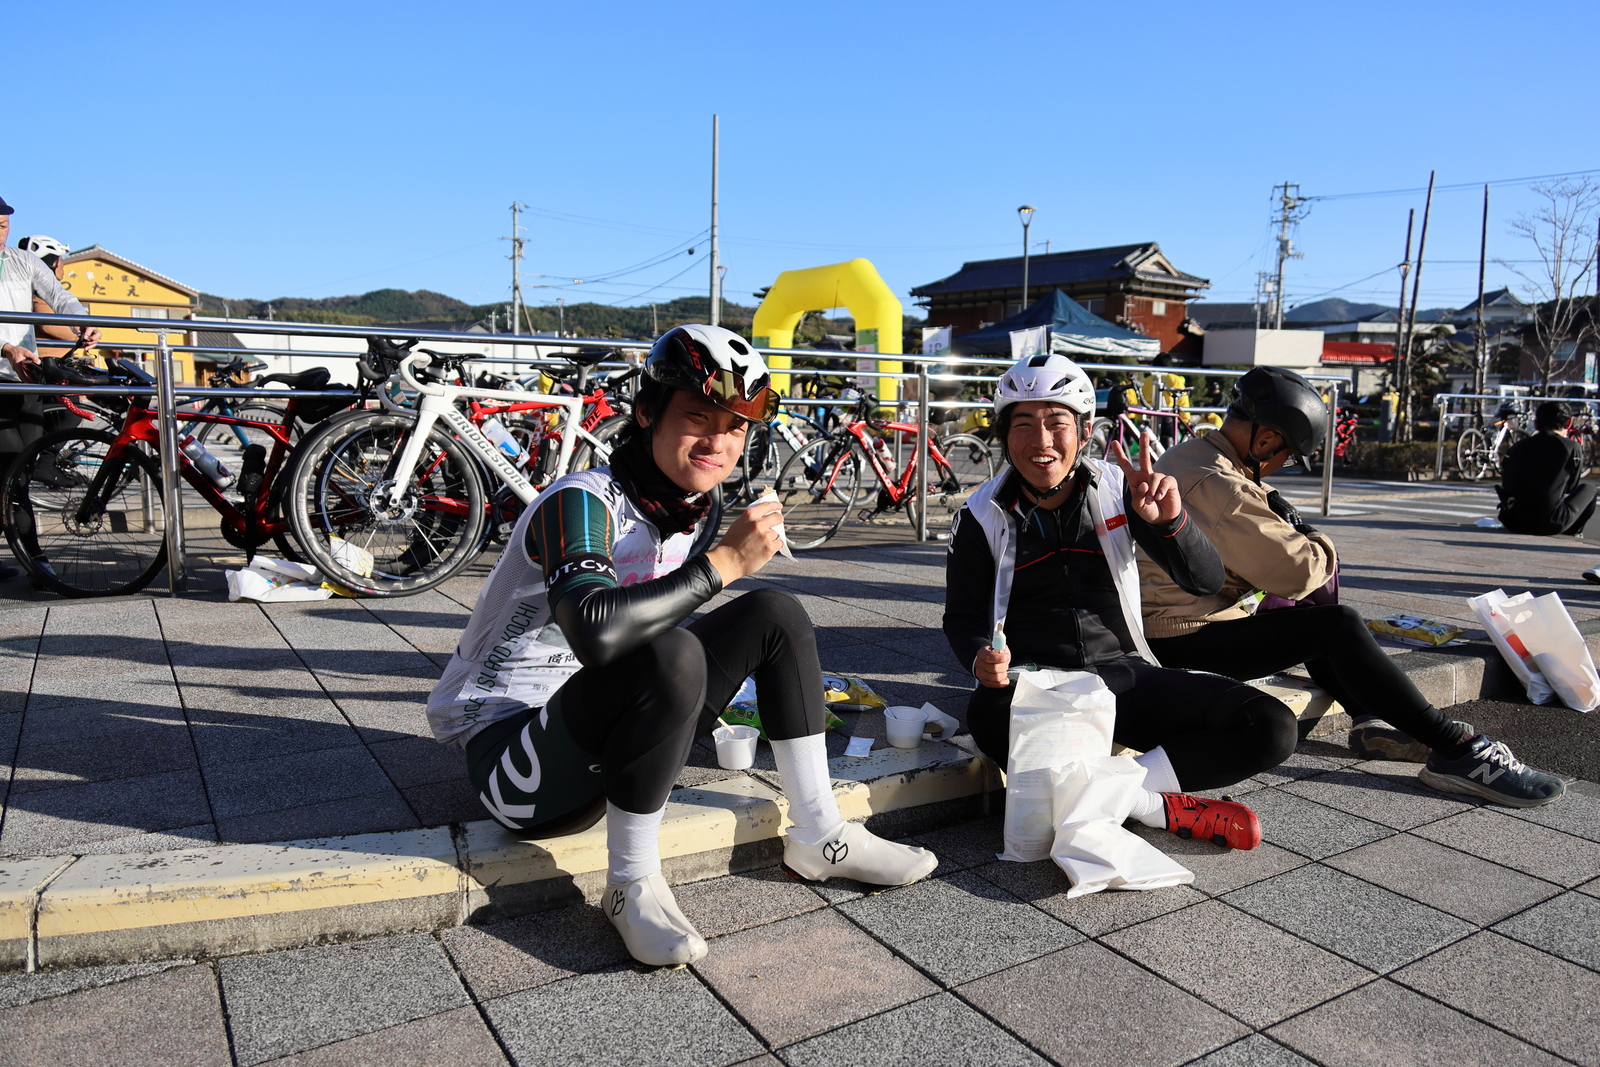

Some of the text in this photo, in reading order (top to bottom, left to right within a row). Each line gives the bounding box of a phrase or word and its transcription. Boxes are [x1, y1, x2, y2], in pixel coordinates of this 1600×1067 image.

[447, 410, 530, 490] BRIDGESTONE
[475, 645, 512, 693] ISLAND
[501, 602, 539, 644] KOCHI
